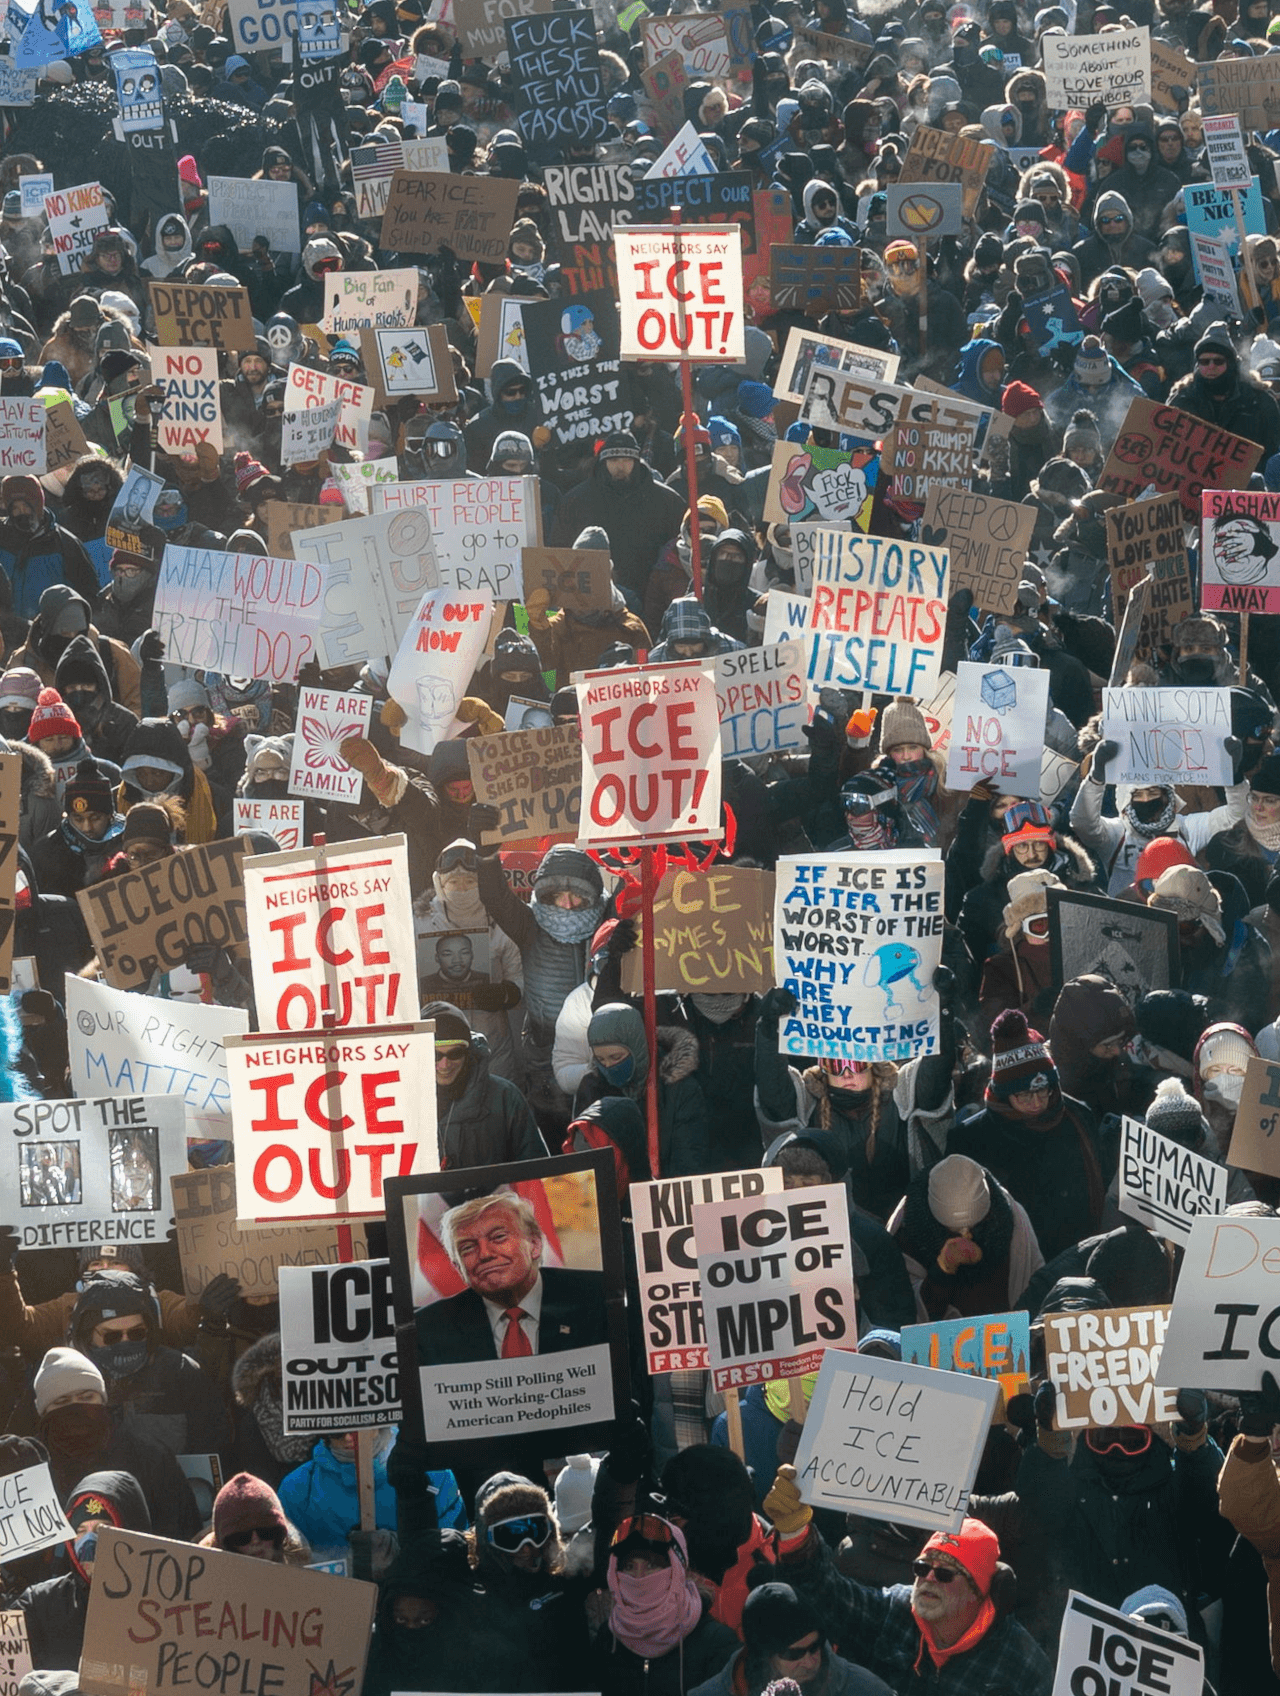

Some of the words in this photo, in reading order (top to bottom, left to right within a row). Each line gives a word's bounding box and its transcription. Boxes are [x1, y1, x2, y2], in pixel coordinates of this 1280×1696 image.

[511, 18, 593, 48] FUCK
[300, 66, 335, 89] OUT
[514, 48, 599, 79] THESE
[1079, 61, 1117, 74] ABOUT
[521, 76, 599, 105] TEMU
[1063, 76, 1102, 92] LOVE
[1108, 71, 1145, 87] YOUR
[132, 134, 165, 148] OUT
[545, 165, 634, 206] RIGHTS
[45, 197, 67, 217] NO
[67, 186, 104, 212] KINGS
[631, 243, 701, 255] NEIGHBORS
[706, 243, 728, 255] SAY
[344, 276, 367, 296] Big
[373, 279, 395, 293] Fan
[634, 259, 726, 304] ICE
[166, 355, 203, 376] NO
[292, 369, 326, 395] GET
[333, 381, 362, 407] ICE
[158, 401, 217, 422] KING
[1152, 411, 1197, 438] GET
[1202, 426, 1248, 463] THE
[2, 450, 36, 467] KING
[453, 503, 523, 524] PEOPLE
[1212, 495, 1279, 519] SASHAY
[816, 532, 949, 598] HISTORY
[444, 604, 484, 622] OUT
[811, 586, 947, 643] REPEATS
[1221, 589, 1269, 610] AWAY
[156, 610, 240, 670] IRISH
[252, 628, 312, 681] DO?
[807, 632, 934, 695] ITSELF
[305, 692, 329, 712] WE
[335, 695, 369, 717] ARE
[587, 680, 669, 705] NEIGHBORS
[674, 677, 700, 693] SAY
[1107, 689, 1229, 725] MINNESOTA
[591, 701, 699, 765] ICE
[967, 715, 1001, 746] NO
[960, 745, 1018, 777] ICE
[1130, 727, 1208, 771] NICE
[294, 769, 359, 794] FAMILY
[238, 803, 263, 820] WE
[269, 803, 300, 820] ARE
[590, 769, 709, 827] OUT!
[266, 880, 358, 911] NEIGHBORS
[364, 877, 392, 897] SAY
[784, 887, 881, 913] AFTER
[890, 891, 941, 911] THE
[783, 906, 871, 935] WORST
[876, 916, 898, 935] OF
[904, 913, 942, 937] THE
[269, 902, 391, 974] ICE
[77, 1008, 129, 1038] OUR
[245, 1044, 367, 1069] NEIGHBORS
[374, 1043, 410, 1062] SAY
[249, 1070, 404, 1134] ICE
[23, 1218, 155, 1247] DIFFERENCE
[720, 1201, 830, 1252] ICE
[707, 1253, 788, 1288] OUT
[795, 1244, 844, 1272] OF
[716, 1288, 847, 1359] MPLS
[1051, 1311, 1173, 1351] TRUTH
[435, 1378, 482, 1395] Trump
[485, 1374, 512, 1390] Still
[517, 1369, 563, 1390] Polling
[566, 1364, 597, 1380] Well
[716, 1362, 774, 1390] FRSO
[780, 1357, 811, 1369] Freedom
[844, 1374, 922, 1422] Hold
[446, 1412, 515, 1430] American
[517, 1404, 592, 1424] Pedophiles
[843, 1426, 921, 1463] ICE
[802, 1456, 969, 1512] ACCOUNTABLE
[103, 1541, 205, 1600] STOP
[128, 1600, 324, 1648] STEALING
[1089, 1623, 1175, 1695] ICE
